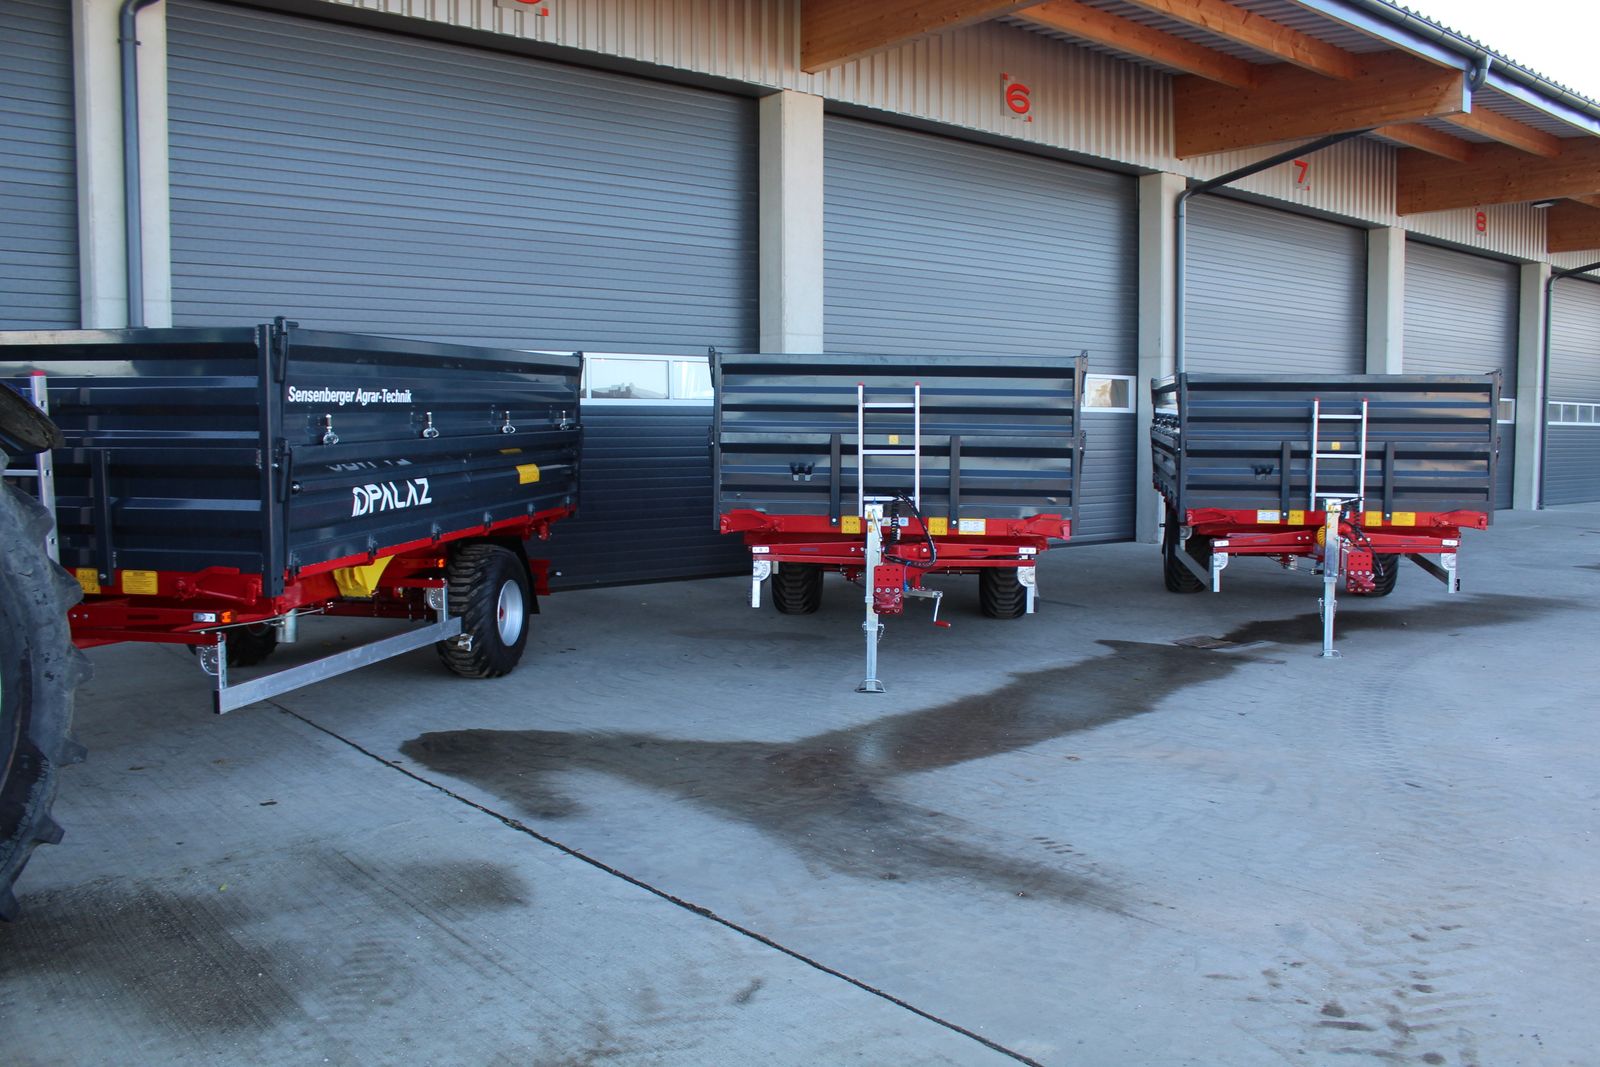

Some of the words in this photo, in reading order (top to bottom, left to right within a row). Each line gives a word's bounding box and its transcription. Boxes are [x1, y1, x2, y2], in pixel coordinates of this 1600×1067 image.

[1006, 83, 1031, 115] 6
[1294, 159, 1309, 183] 7
[1475, 211, 1487, 232] 8
[288, 386, 355, 410] Sensenberger
[355, 388, 412, 410] Agrar-Technik
